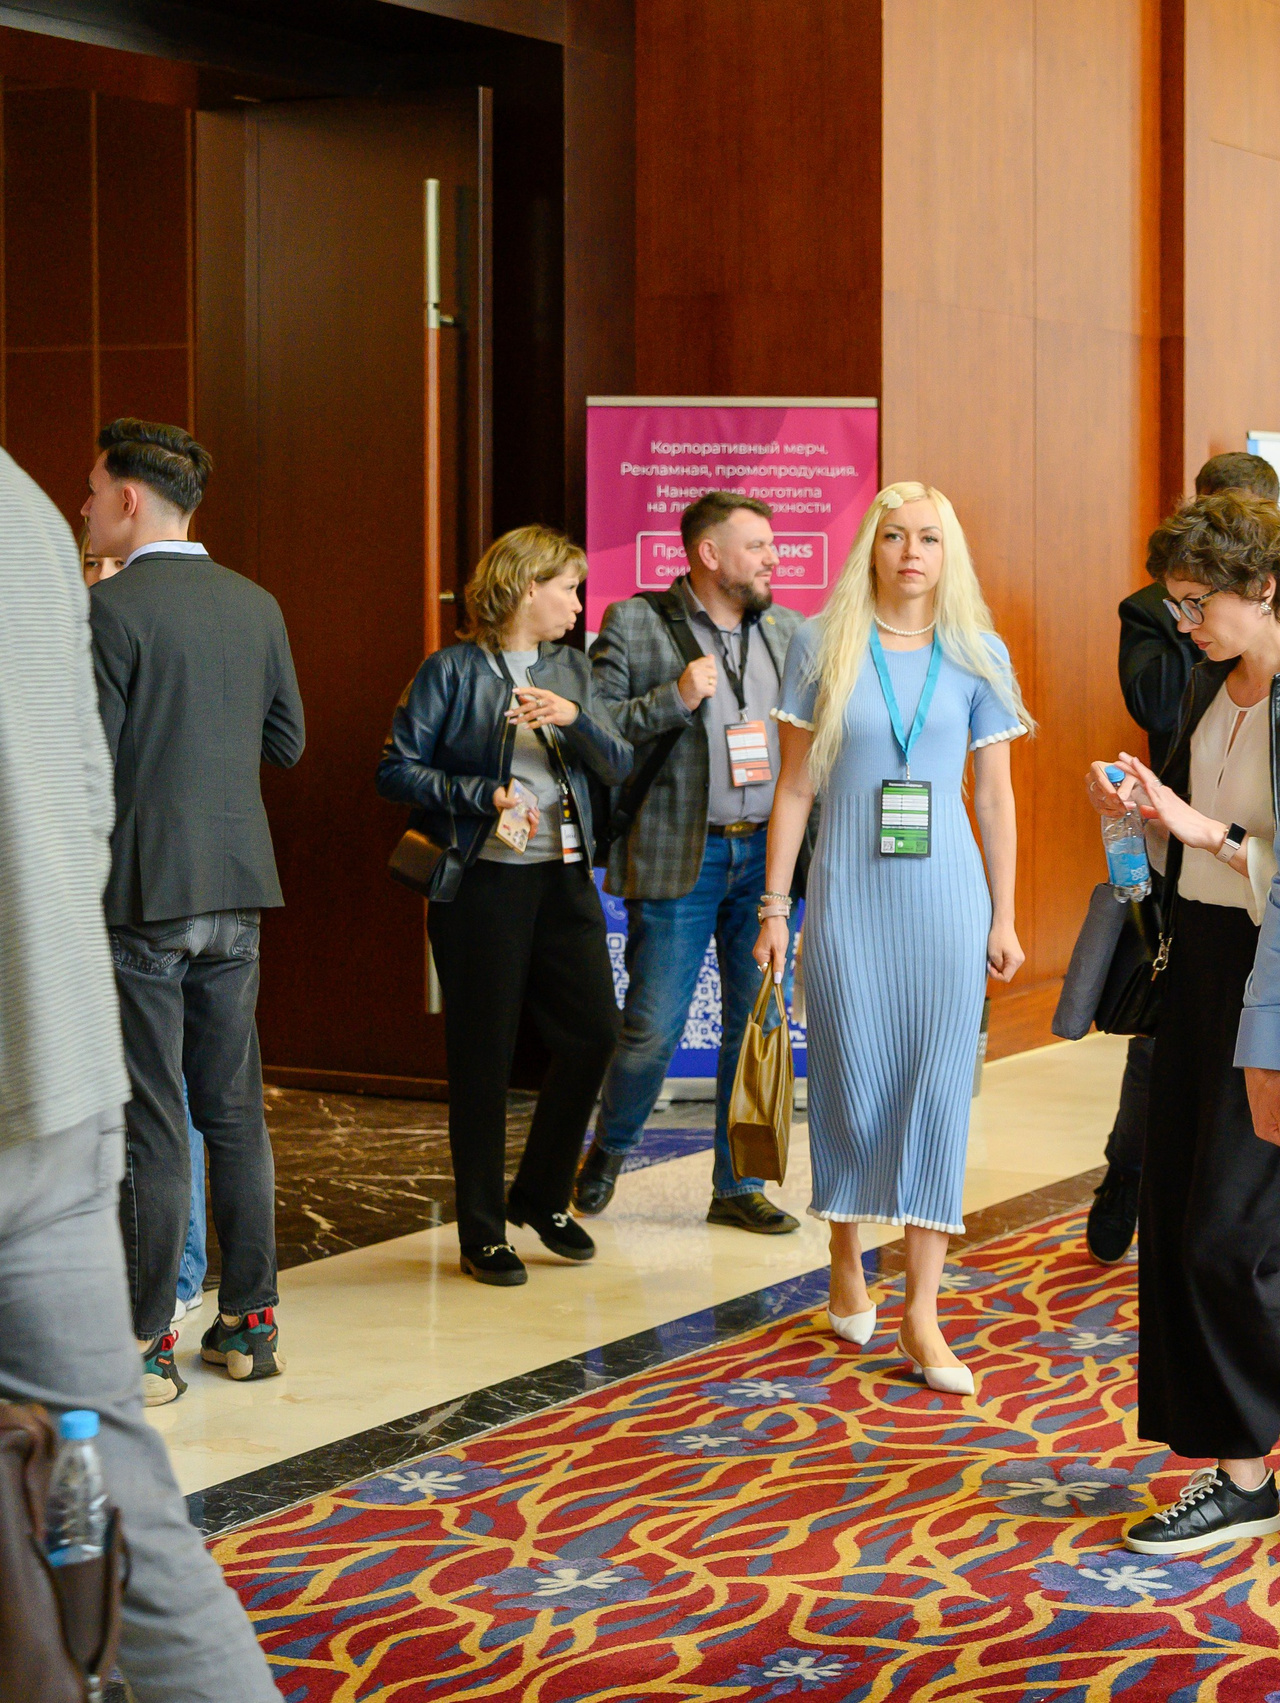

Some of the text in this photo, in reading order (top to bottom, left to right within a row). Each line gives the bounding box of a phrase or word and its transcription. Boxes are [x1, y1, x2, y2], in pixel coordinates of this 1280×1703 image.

[650, 441, 828, 457] Корпоративный мерч.
[620, 462, 858, 479] Рекламная, промопродукция.
[749, 487, 822, 499] логотипа
[647, 501, 667, 513] на
